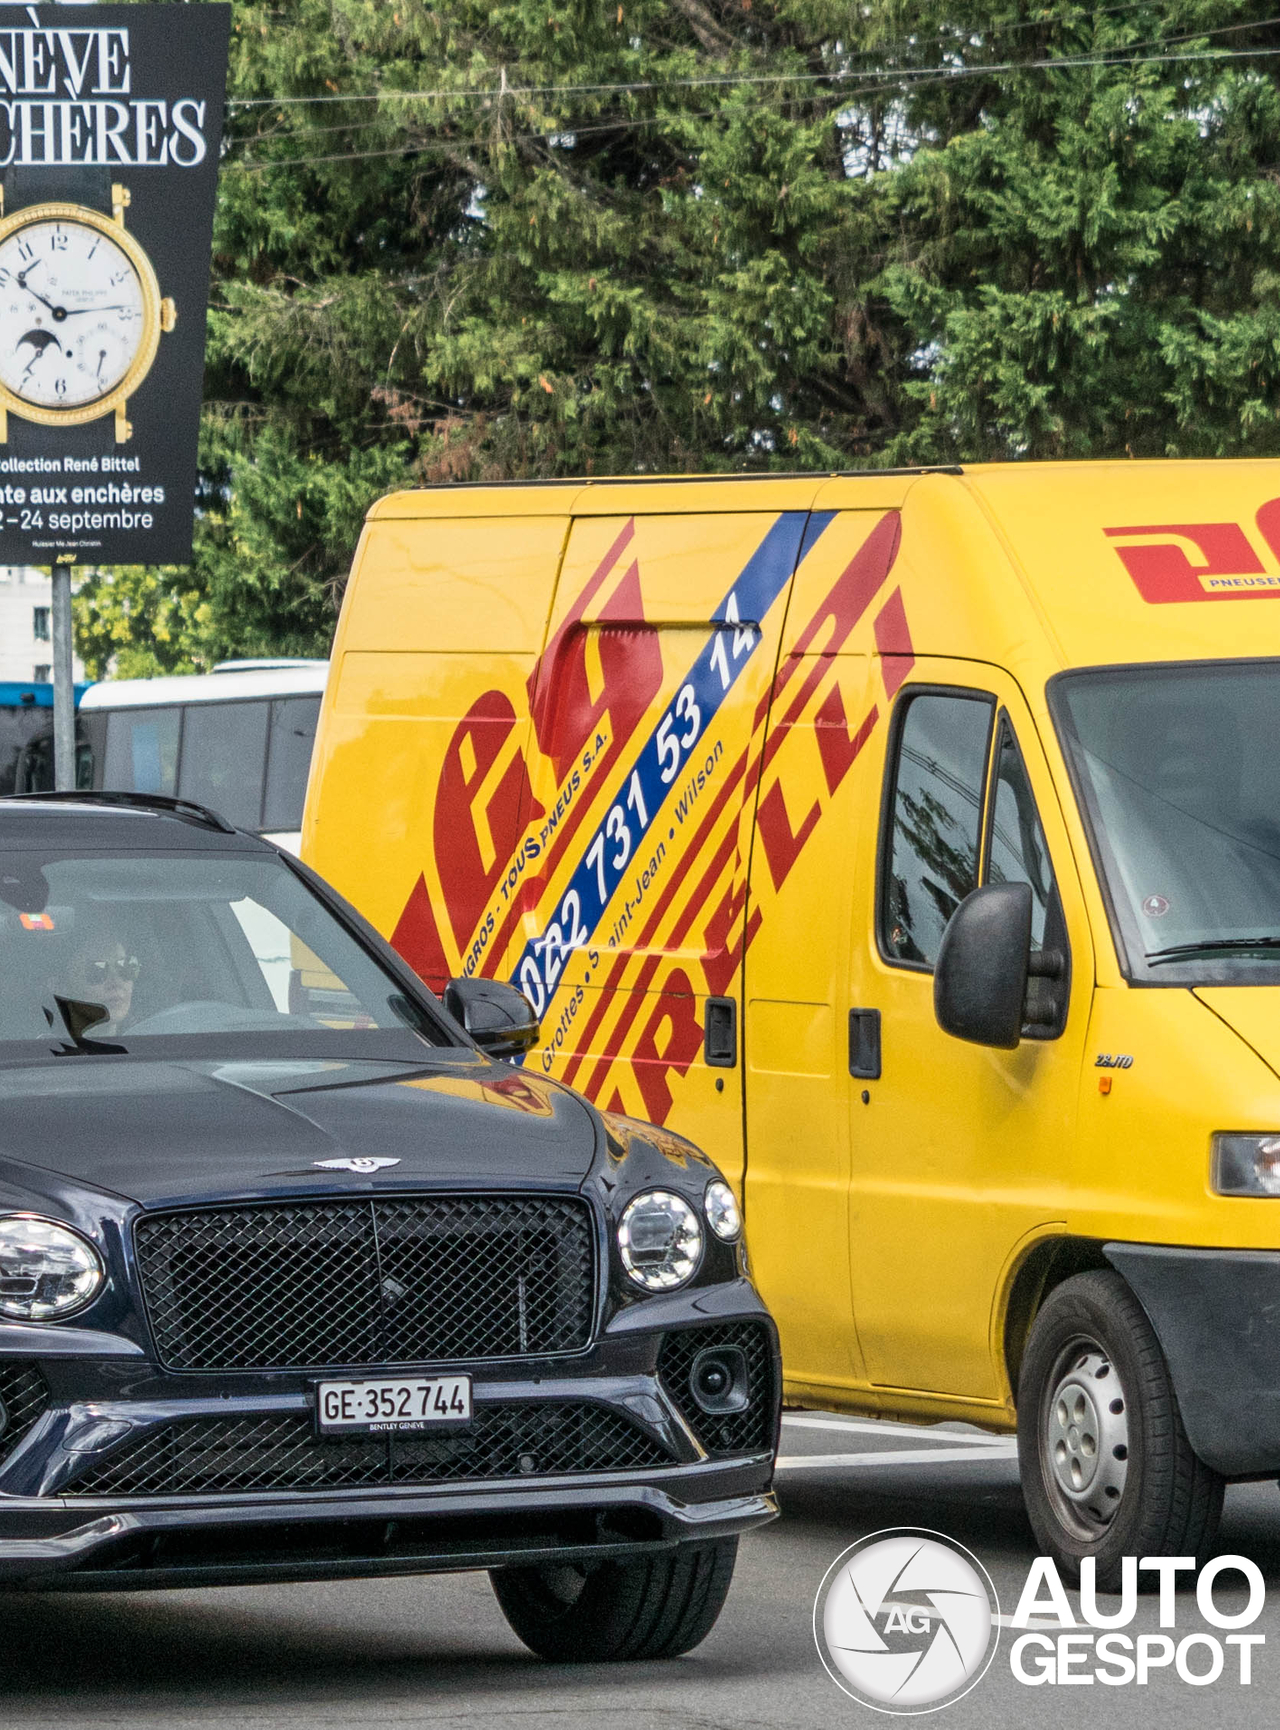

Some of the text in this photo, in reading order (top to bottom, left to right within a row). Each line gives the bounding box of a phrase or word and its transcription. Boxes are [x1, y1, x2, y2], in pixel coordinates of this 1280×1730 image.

[64, 456, 98, 471] René
[102, 456, 140, 471] Bittel
[29, 487, 67, 504] aux
[71, 482, 165, 504] enchères
[48, 509, 154, 533] septembre
[1209, 577, 1280, 588] PNEUSE
[500, 837, 541, 900] TOUS
[539, 770, 580, 848] PNEUS
[583, 733, 608, 773] S.A.
[520, 591, 755, 1018] 022 731 53 14
[541, 984, 584, 1073] Grottes
[674, 739, 724, 825] Wilson
